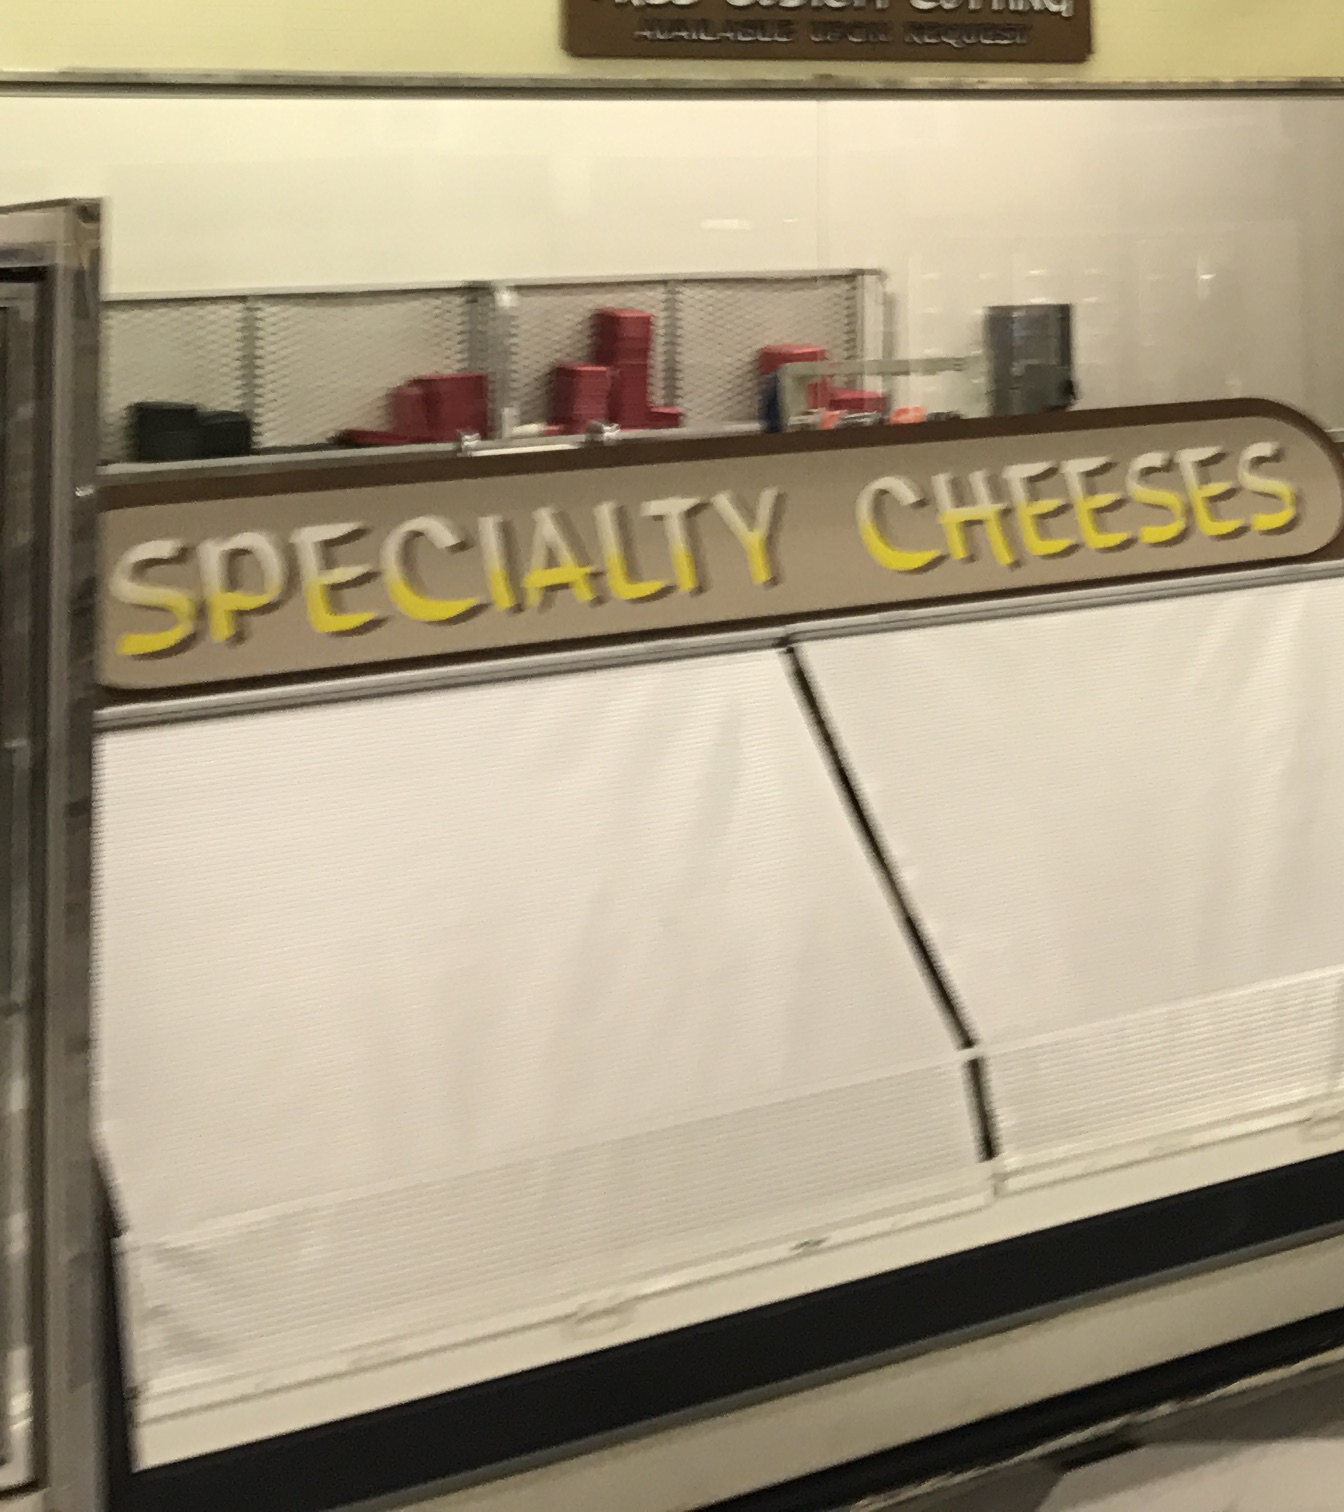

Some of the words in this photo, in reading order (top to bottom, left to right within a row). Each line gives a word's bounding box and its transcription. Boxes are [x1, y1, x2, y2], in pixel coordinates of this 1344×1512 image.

[634, 18, 794, 42] AVAILABLE
[904, 22, 1030, 48] REQUEST
[106, 486, 786, 657] SPECIALTY
[856, 439, 1301, 574] CHEESES
